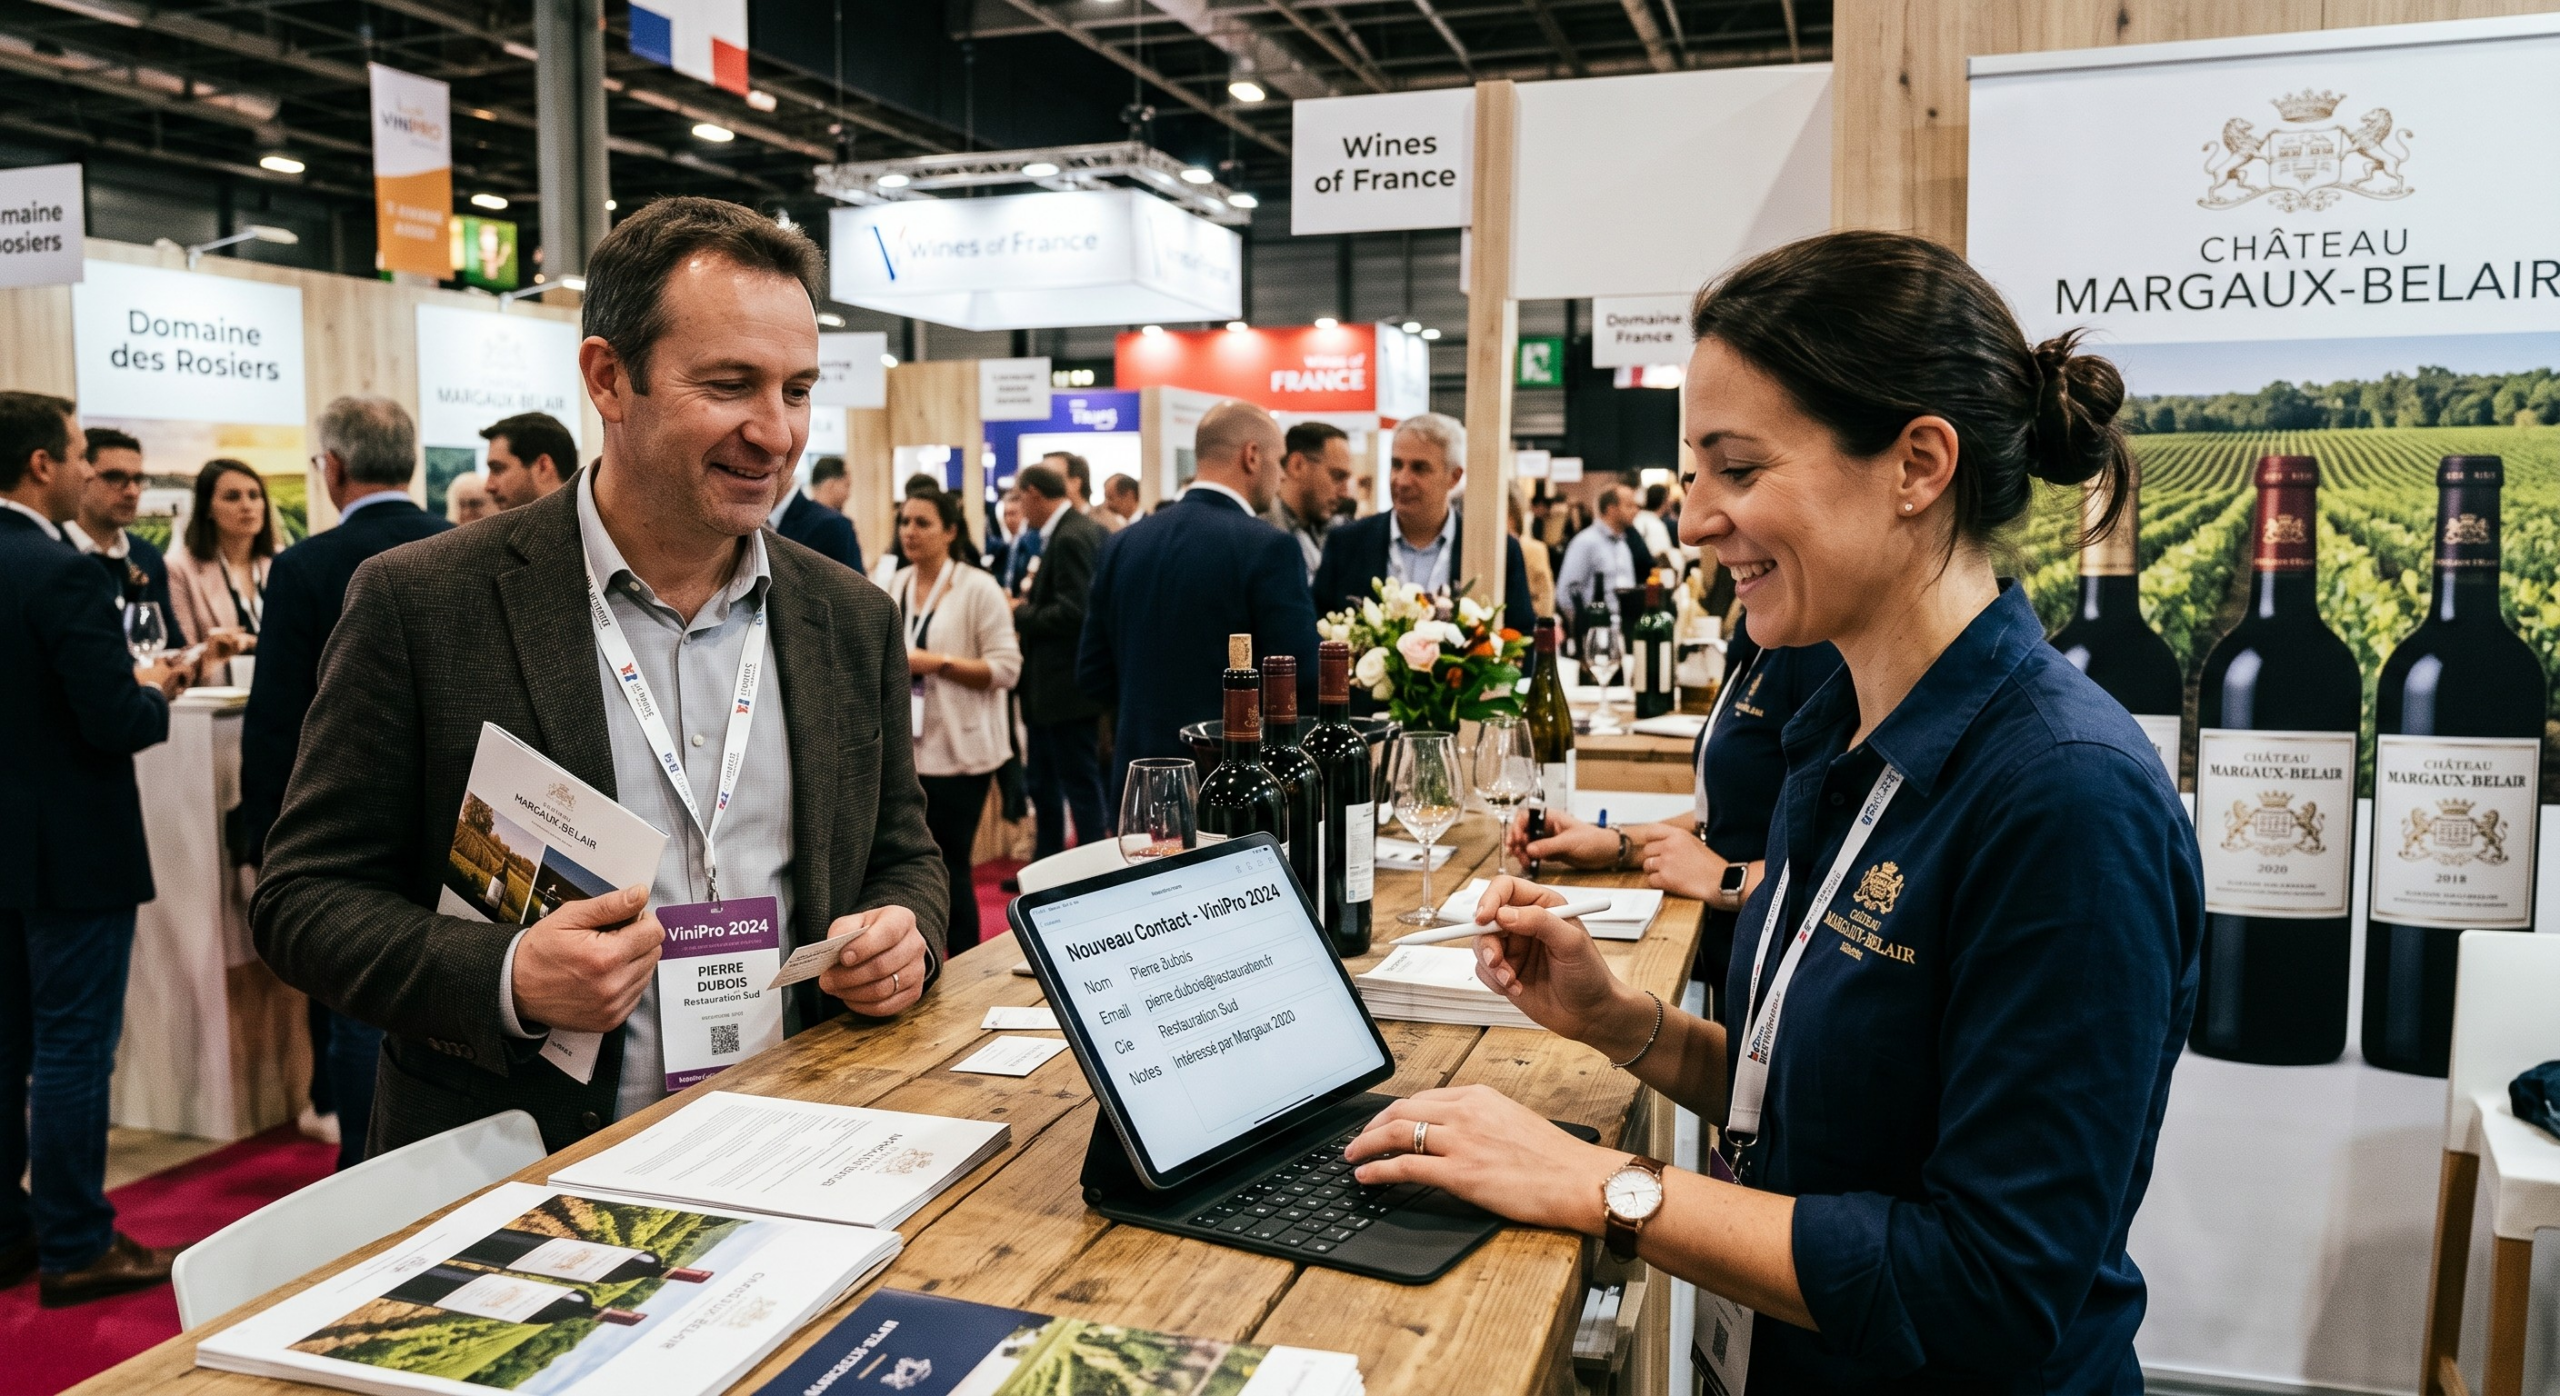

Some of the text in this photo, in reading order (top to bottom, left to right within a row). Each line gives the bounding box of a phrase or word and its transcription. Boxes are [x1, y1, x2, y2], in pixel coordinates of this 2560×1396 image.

[1343, 132, 1438, 159] Wines
[1314, 168, 1456, 193] of France
[0, 230, 63, 254] osiers
[1012, 231, 1098, 253] France
[2200, 227, 2409, 263] CHÂTEAU
[2056, 260, 2560, 314] MARGAUX-BELAIR
[129, 310, 261, 346] Domaine
[1606, 311, 1681, 328] Domaine
[1616, 329, 1674, 345] France
[111, 343, 280, 381] des Rosiers
[1270, 368, 1367, 393] FRANCE
[2209, 764, 2344, 781] MARGAUX-BELAIR
[2387, 771, 2527, 788] MARGAUX-BELAIR
[668, 918, 769, 942] ViniPro 2024
[1065, 929, 1136, 963] Nouveau
[1134, 910, 1192, 941] Contact
[1197, 895, 1247, 922] ViniPro
[1245, 883, 1281, 907] 2024
[698, 961, 744, 977] PIERRE
[1129, 960, 1161, 980] Pierre
[697, 976, 748, 993] DUBOIS
[1084, 976, 1113, 995] Nom
[683, 989, 761, 1007] Restauration Sud
[1099, 1003, 1132, 1026] Email
[1157, 998, 1240, 1039] Restauration Sud
[1114, 1038, 1136, 1055] Cie
[1171, 1009, 1297, 1069] Intéressé par Margaux 2020
[1129, 1064, 1163, 1086] Notes
